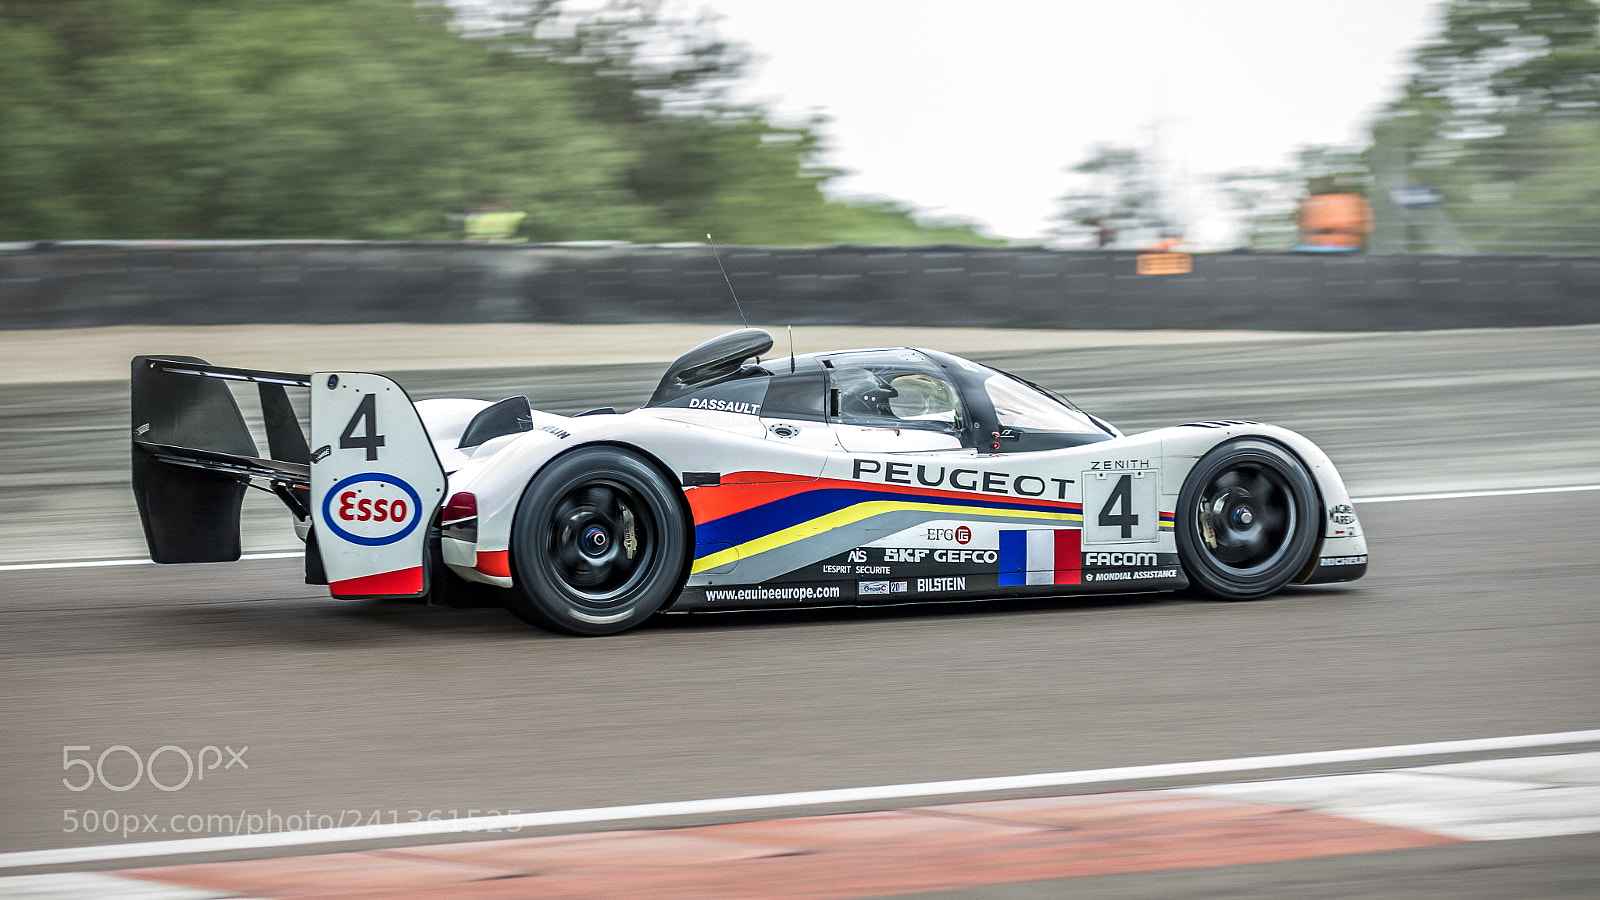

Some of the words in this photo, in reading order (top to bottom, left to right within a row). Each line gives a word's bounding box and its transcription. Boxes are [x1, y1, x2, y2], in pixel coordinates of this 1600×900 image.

[688, 397, 760, 415] DASSAULT
[339, 393, 386, 462] 4
[1090, 459, 1150, 470] ZENITH
[852, 458, 1075, 500] PEUGEOT
[1098, 474, 1139, 539] 4
[926, 528, 954, 541] EFG
[883, 548, 930, 563] SKF
[933, 550, 998, 564] GEFCO
[1085, 552, 1158, 566] FACOM
[822, 564, 852, 575] L'ESPRIT
[855, 565, 891, 575] SECURITE
[1095, 571, 1132, 582] MONDIAL
[1132, 569, 1177, 580] ASSISTANCE
[917, 577, 966, 592] BILSTEIN
